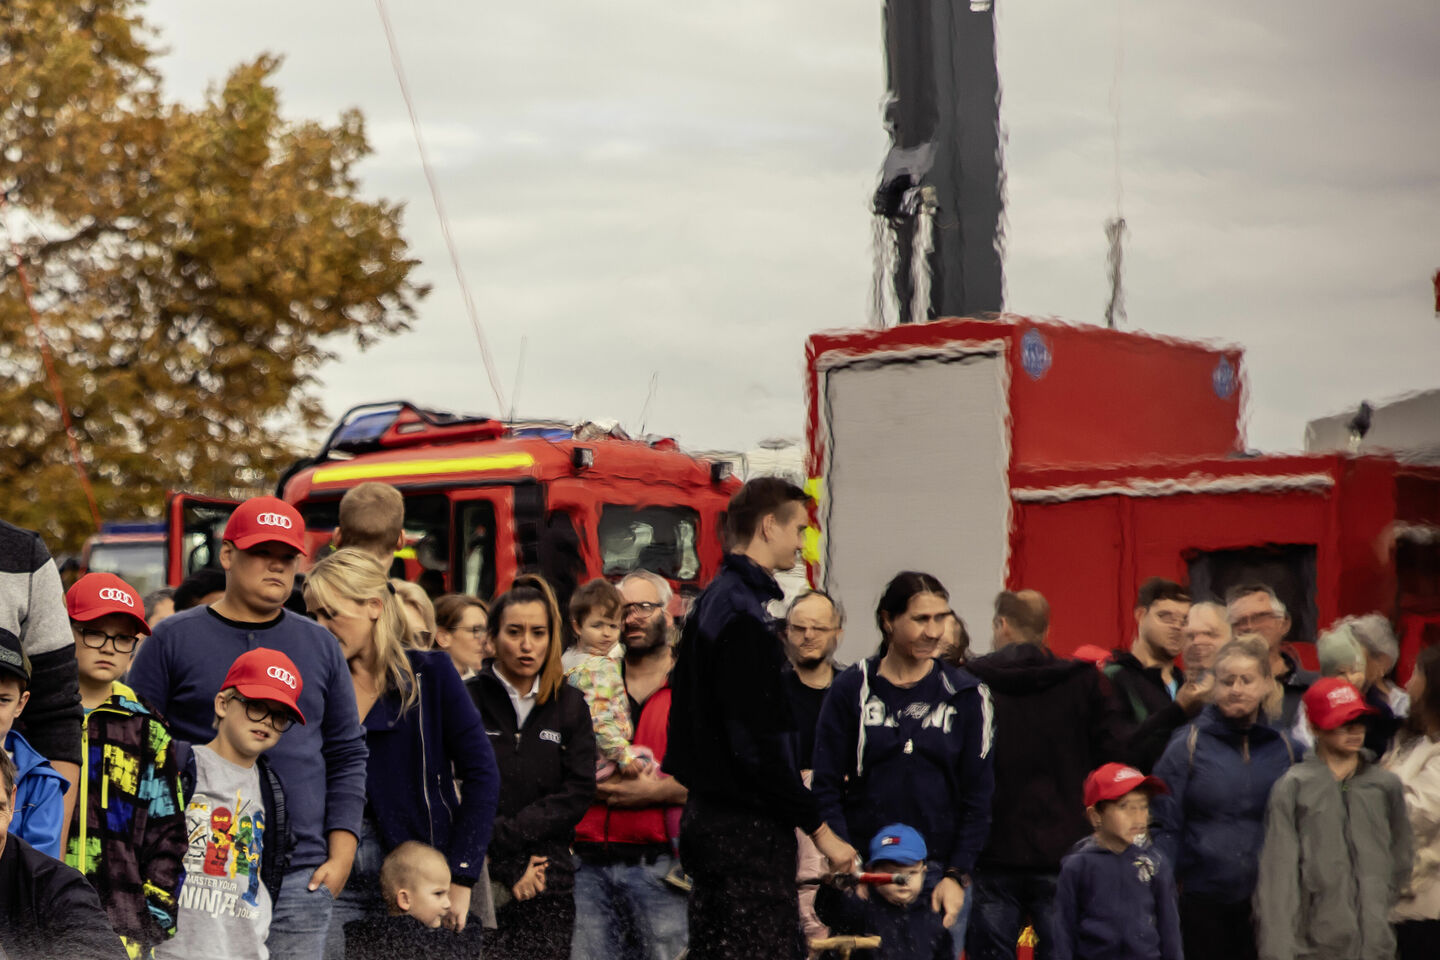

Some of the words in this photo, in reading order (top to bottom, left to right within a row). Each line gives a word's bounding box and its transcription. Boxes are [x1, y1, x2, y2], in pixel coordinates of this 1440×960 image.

[186, 874, 217, 886] MASTER
[219, 880, 238, 891] YOUR
[178, 884, 239, 919] NINJA
